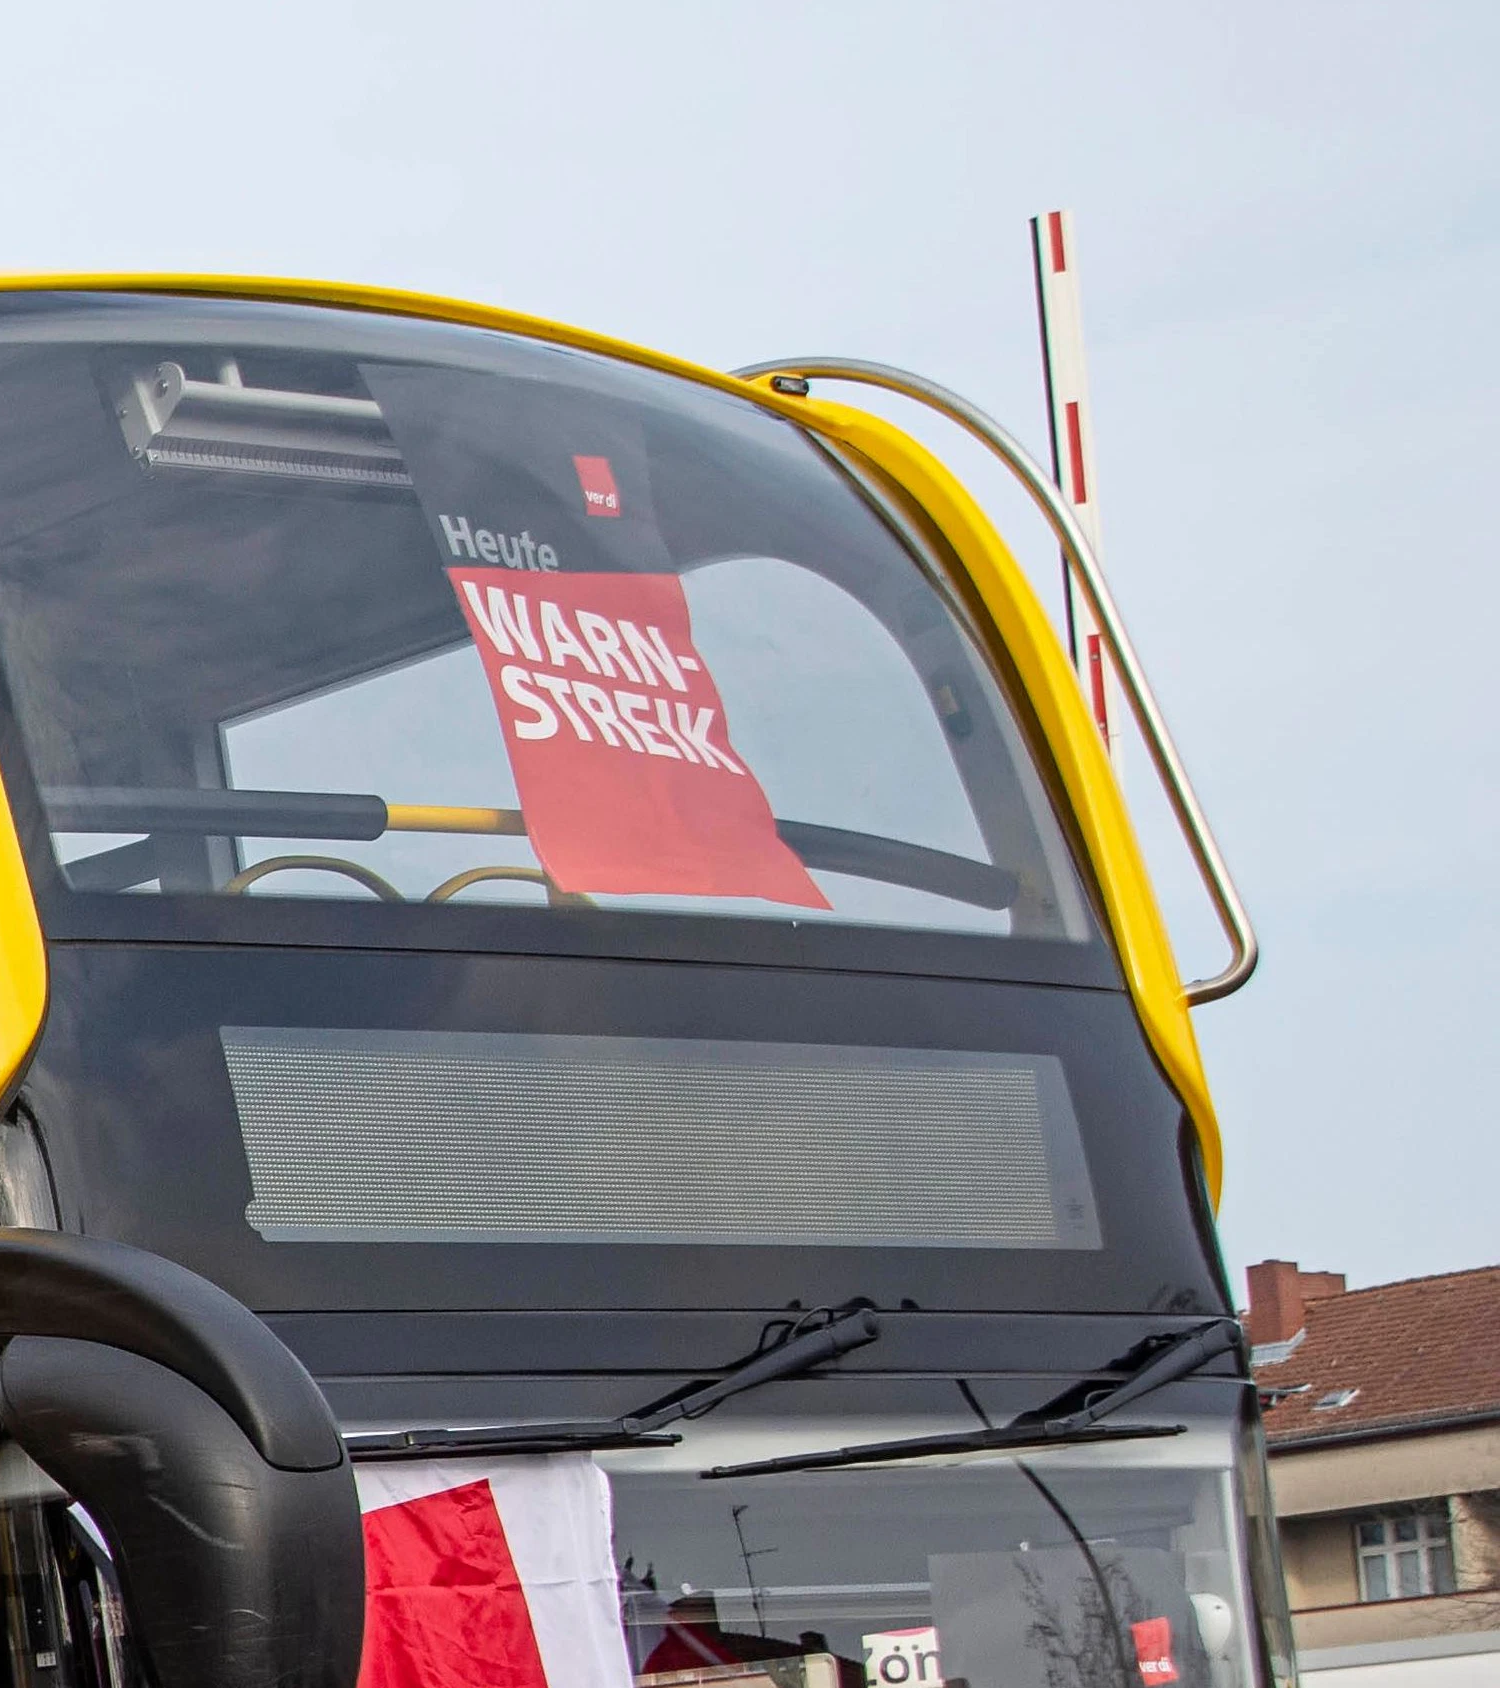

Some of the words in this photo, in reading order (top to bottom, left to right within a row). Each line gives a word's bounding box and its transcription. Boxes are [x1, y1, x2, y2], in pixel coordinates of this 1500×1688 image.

[439, 515, 558, 574] Heute
[460, 580, 701, 695] WARN-
[499, 664, 745, 777] STREIK
